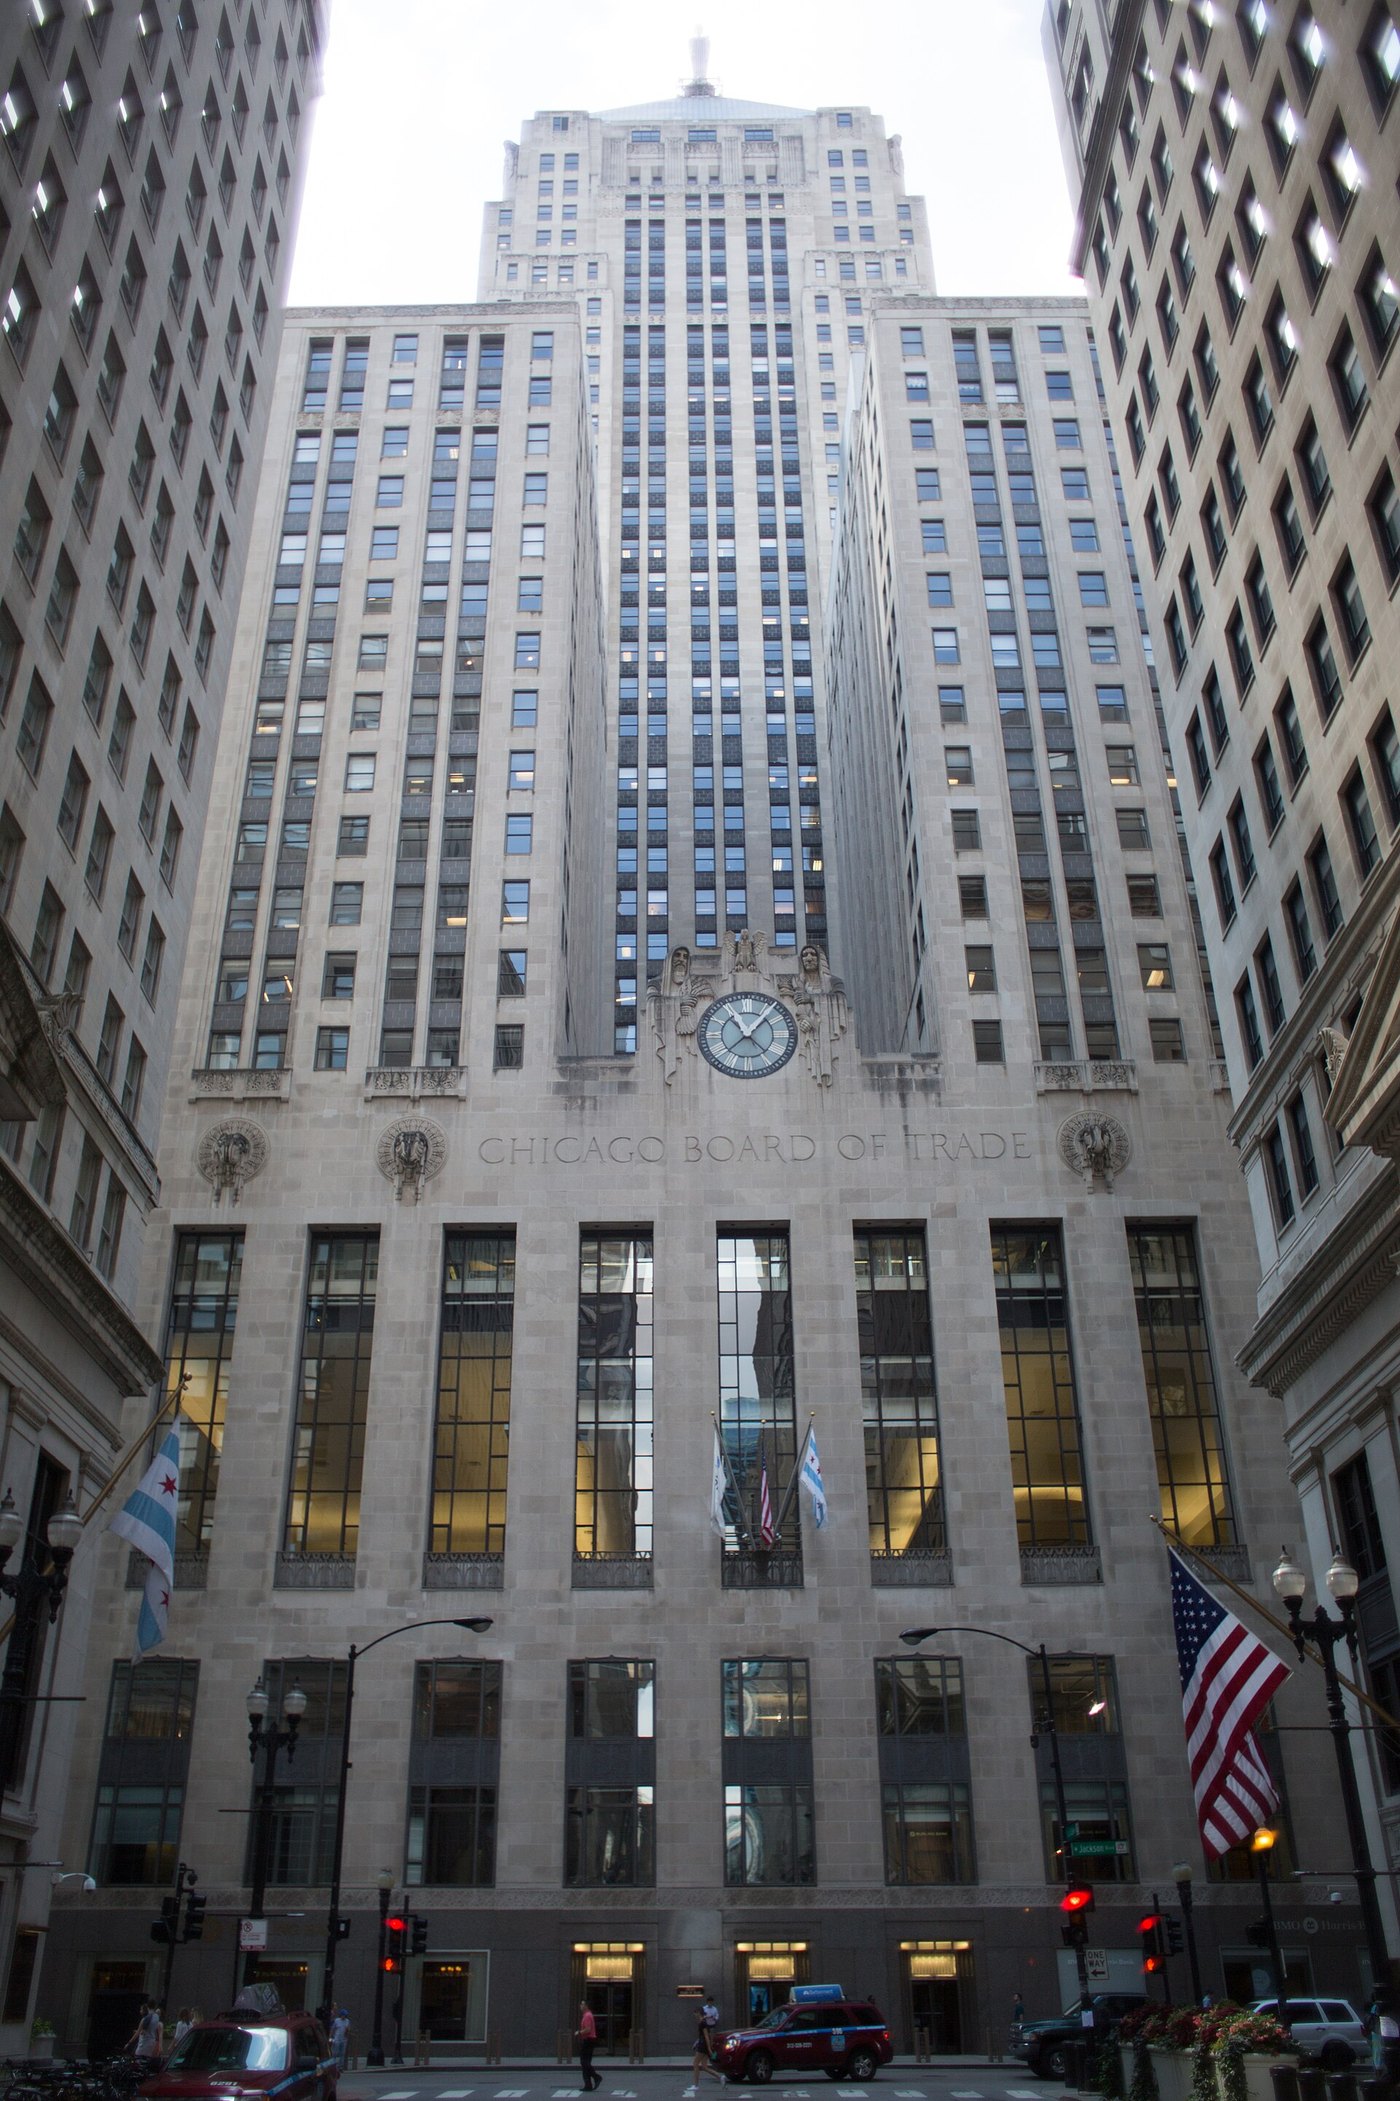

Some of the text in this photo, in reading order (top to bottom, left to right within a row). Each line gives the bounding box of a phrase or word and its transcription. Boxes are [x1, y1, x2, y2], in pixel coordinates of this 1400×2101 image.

[741, 998, 753, 1013] XII
[478, 1132, 1032, 1164] CHICAGO BOARD OF TRADE
[1080, 1843, 1104, 1853] Jackson
[1273, 1920, 1300, 1930] BMO
[1321, 1920, 1355, 1930] Harris
[1088, 1951, 1105, 1959] ONE
[1088, 1960, 1106, 1968] WAY
